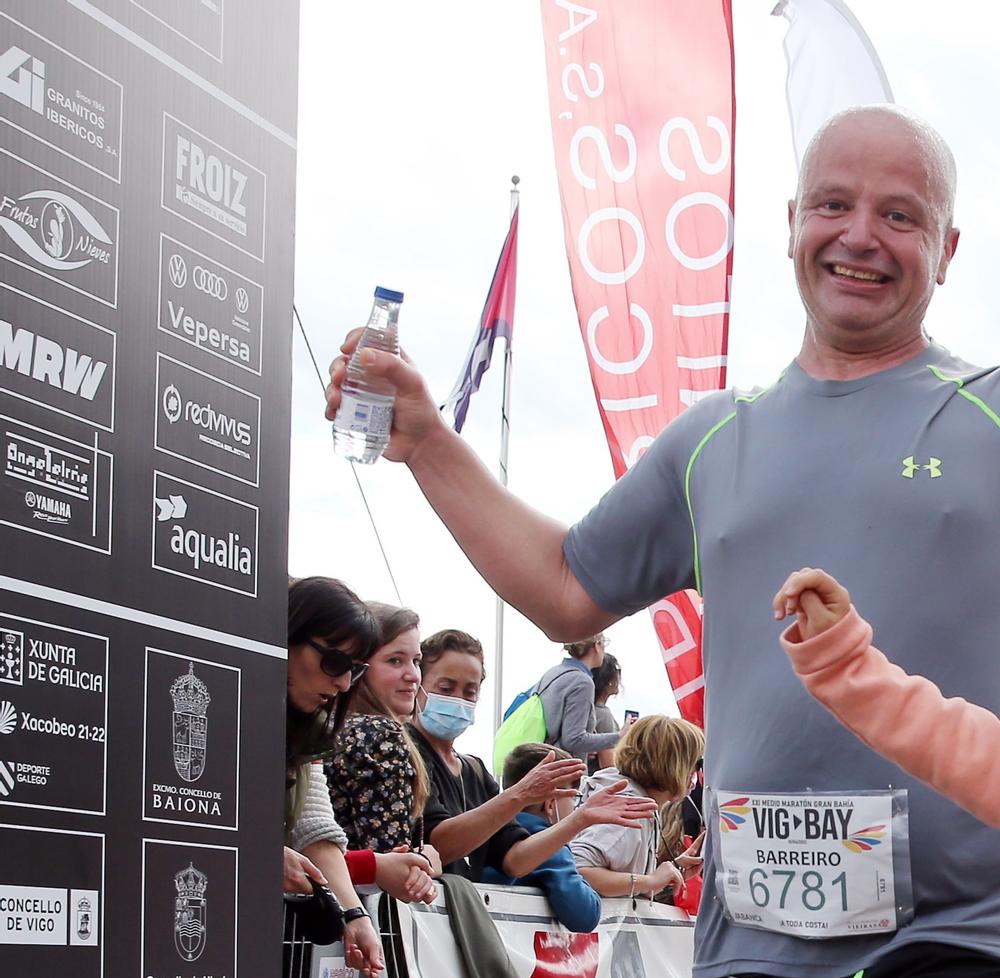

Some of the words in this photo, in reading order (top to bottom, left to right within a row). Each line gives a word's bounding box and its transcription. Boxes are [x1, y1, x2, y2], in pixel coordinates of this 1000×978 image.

[47, 88, 105, 129] GRANITOS
[47, 107, 103, 149] IBERICOS
[176, 135, 248, 217] FROIZ
[0, 196, 39, 229] Frutas
[75, 236, 110, 264] Nieves
[168, 300, 250, 362] Vepersa
[0, 320, 107, 401] MRW
[36, 494, 71, 519] YAMAHA
[171, 525, 251, 575] aqualia
[28, 638, 76, 666] XUNTA
[28, 662, 46, 681] DE
[48, 666, 103, 693] GALICIA
[21, 712, 76, 737] Xacobeo
[16, 763, 50, 776] DEPORTE
[17, 773, 47, 785] GALEGO
[152, 784, 178, 795] EXCMO.
[179, 787, 213, 799] CONCELLO
[213, 791, 222, 800] DE
[153, 794, 222, 816] BAIONA
[762, 799, 780, 807] MEDIO
[782, 799, 813, 808] MARATÓN
[752, 807, 790, 839] VIG
[804, 809, 853, 840] BAY
[757, 850, 841, 866] BARREIRO
[749, 868, 849, 912] 6781
[0, 897, 62, 914] CONCELLO
[7, 917, 22, 931] DE
[26, 918, 55, 932] VIGO
